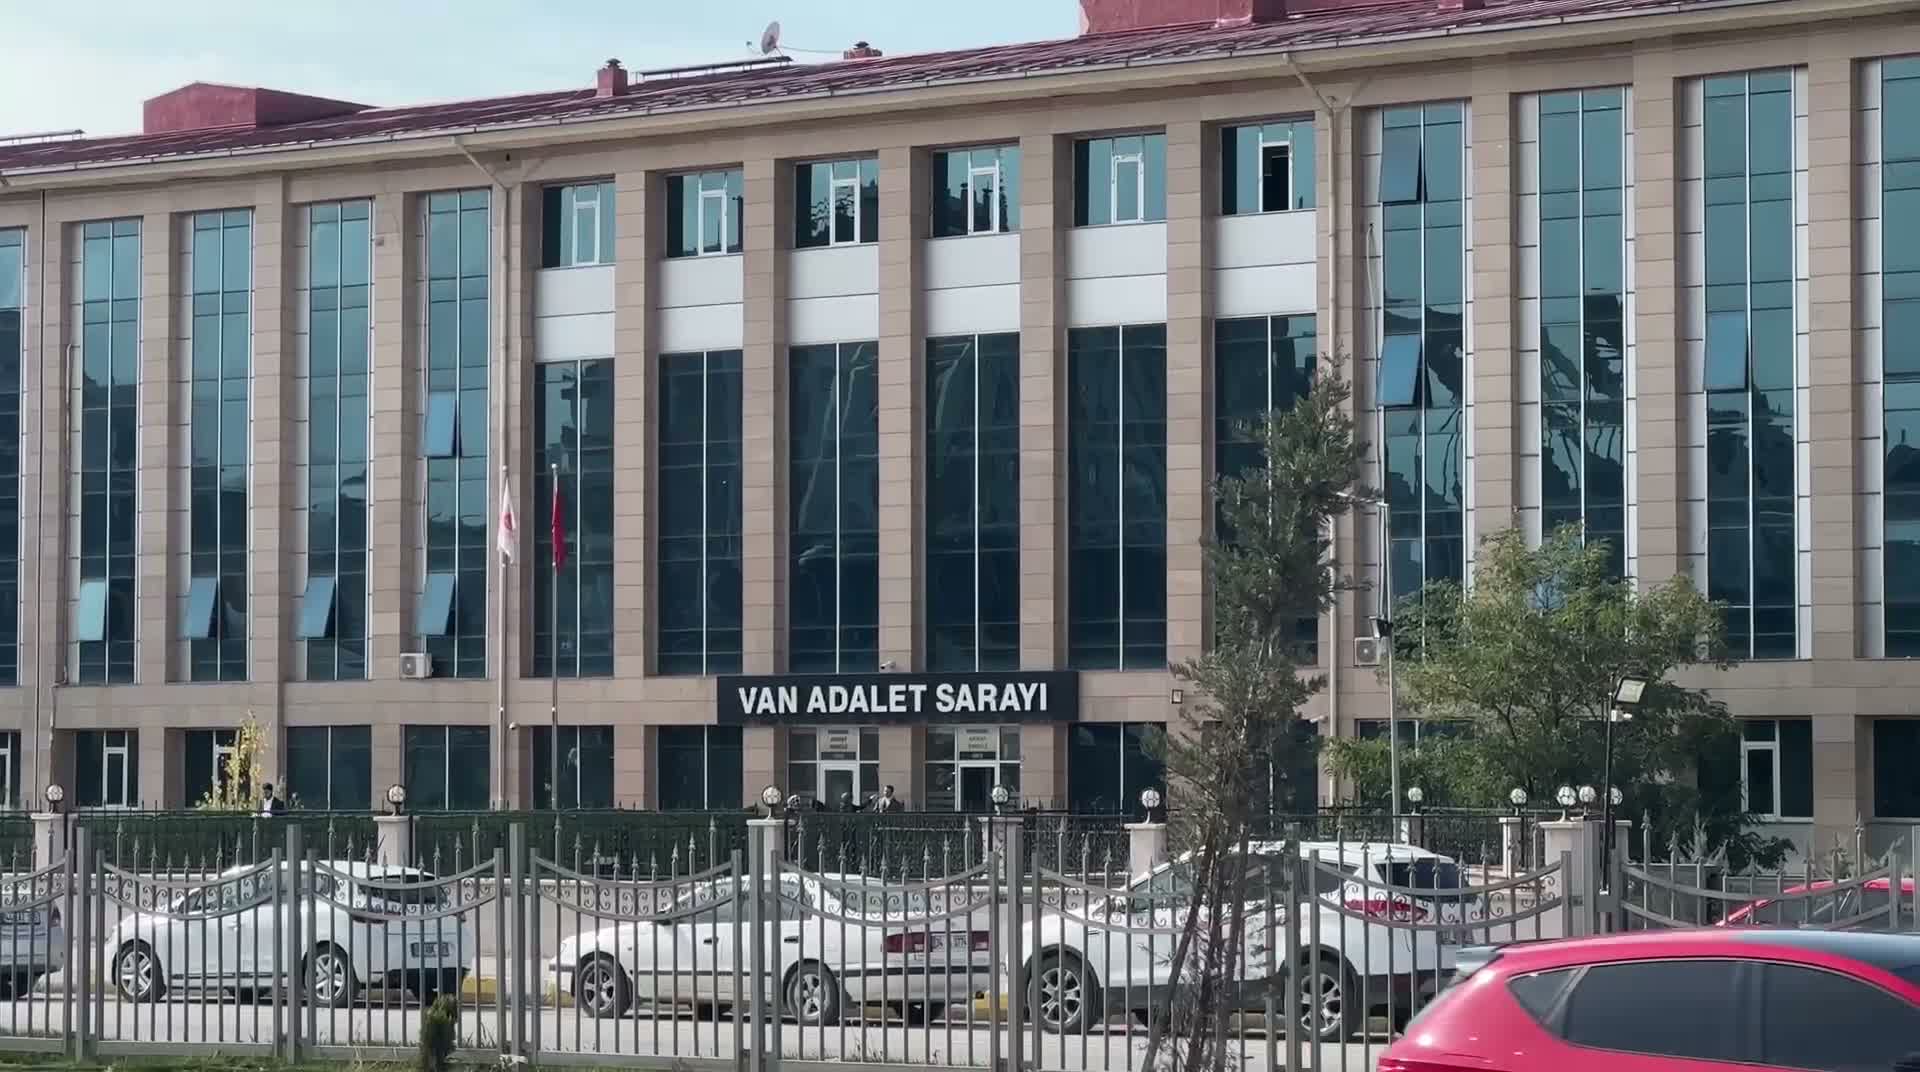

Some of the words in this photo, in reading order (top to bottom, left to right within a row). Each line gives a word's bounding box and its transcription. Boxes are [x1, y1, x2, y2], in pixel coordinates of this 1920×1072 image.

[738, 686, 798, 714] VAN
[806, 684, 927, 713] ADALET
[935, 682, 1047, 712] SARAYI
